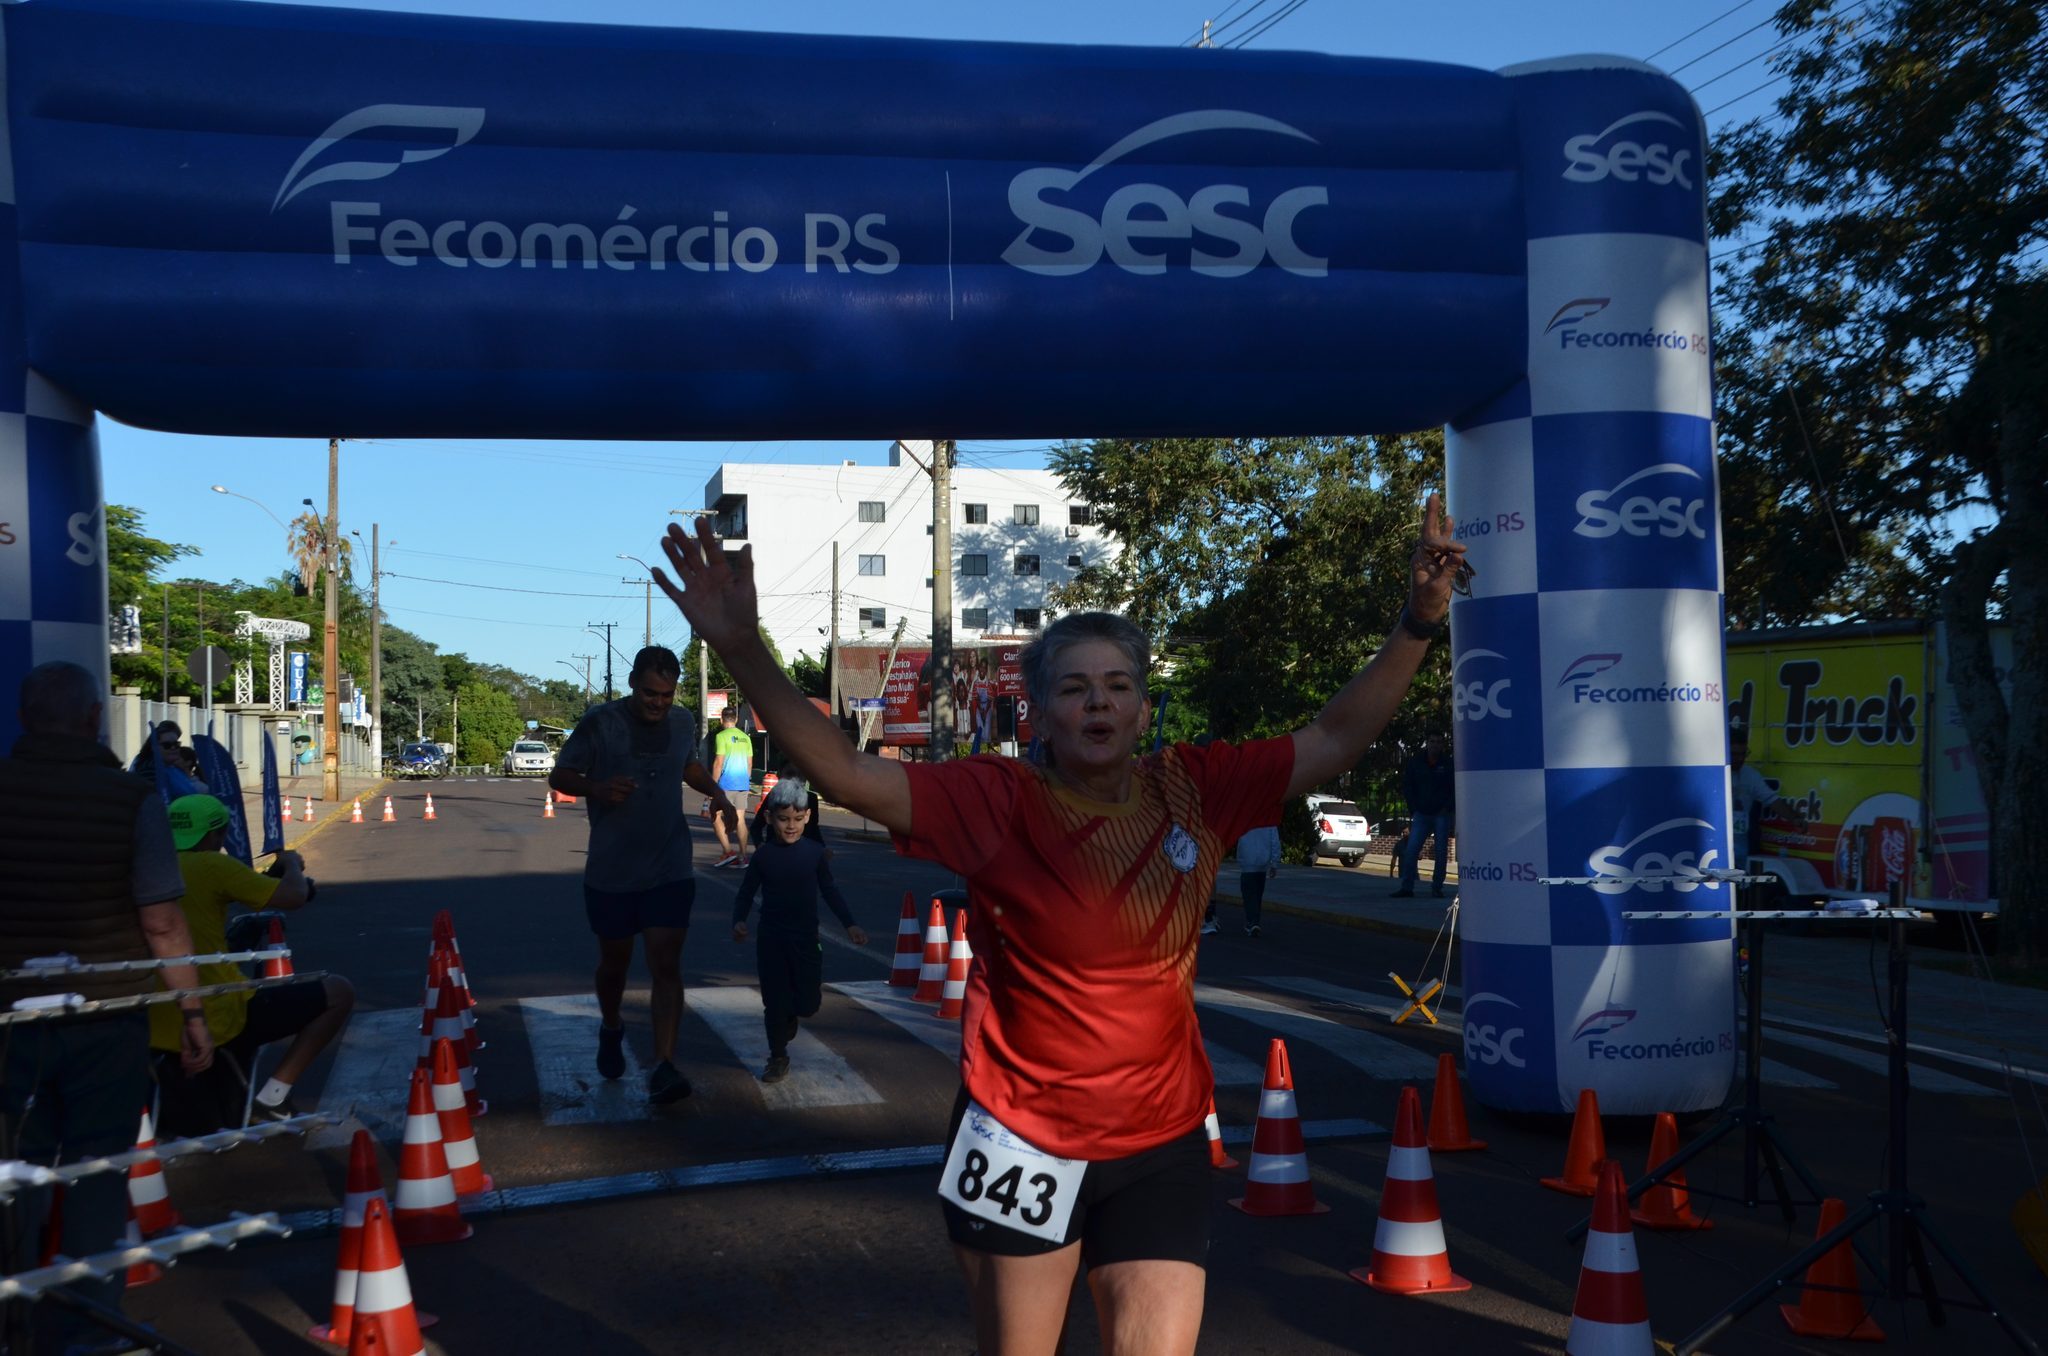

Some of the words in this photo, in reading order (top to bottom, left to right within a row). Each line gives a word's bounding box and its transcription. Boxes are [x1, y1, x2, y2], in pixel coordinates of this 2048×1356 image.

[1561, 132, 1693, 190] Sesc
[330, 199, 779, 274] Fecomércio
[804, 211, 901, 274] RS
[1000, 164, 1329, 277] Sesc
[1560, 327, 1687, 350] Fecomércio
[1691, 333, 1708, 355] RS
[1497, 511, 1525, 533] RS
[1572, 488, 1706, 540] Sesc
[1454, 678, 1512, 722] esc
[1574, 682, 1701, 703] Fecomércio
[1705, 683, 1721, 702] RS
[1778, 659, 1918, 747] Truck
[1509, 862, 1538, 881] RS
[1587, 844, 1720, 895] Sesc
[1464, 1021, 1526, 1068] esc
[1588, 1036, 1715, 1060] Fecomércio
[1718, 1031, 1733, 1053] RS
[957, 1147, 1058, 1226] 843
